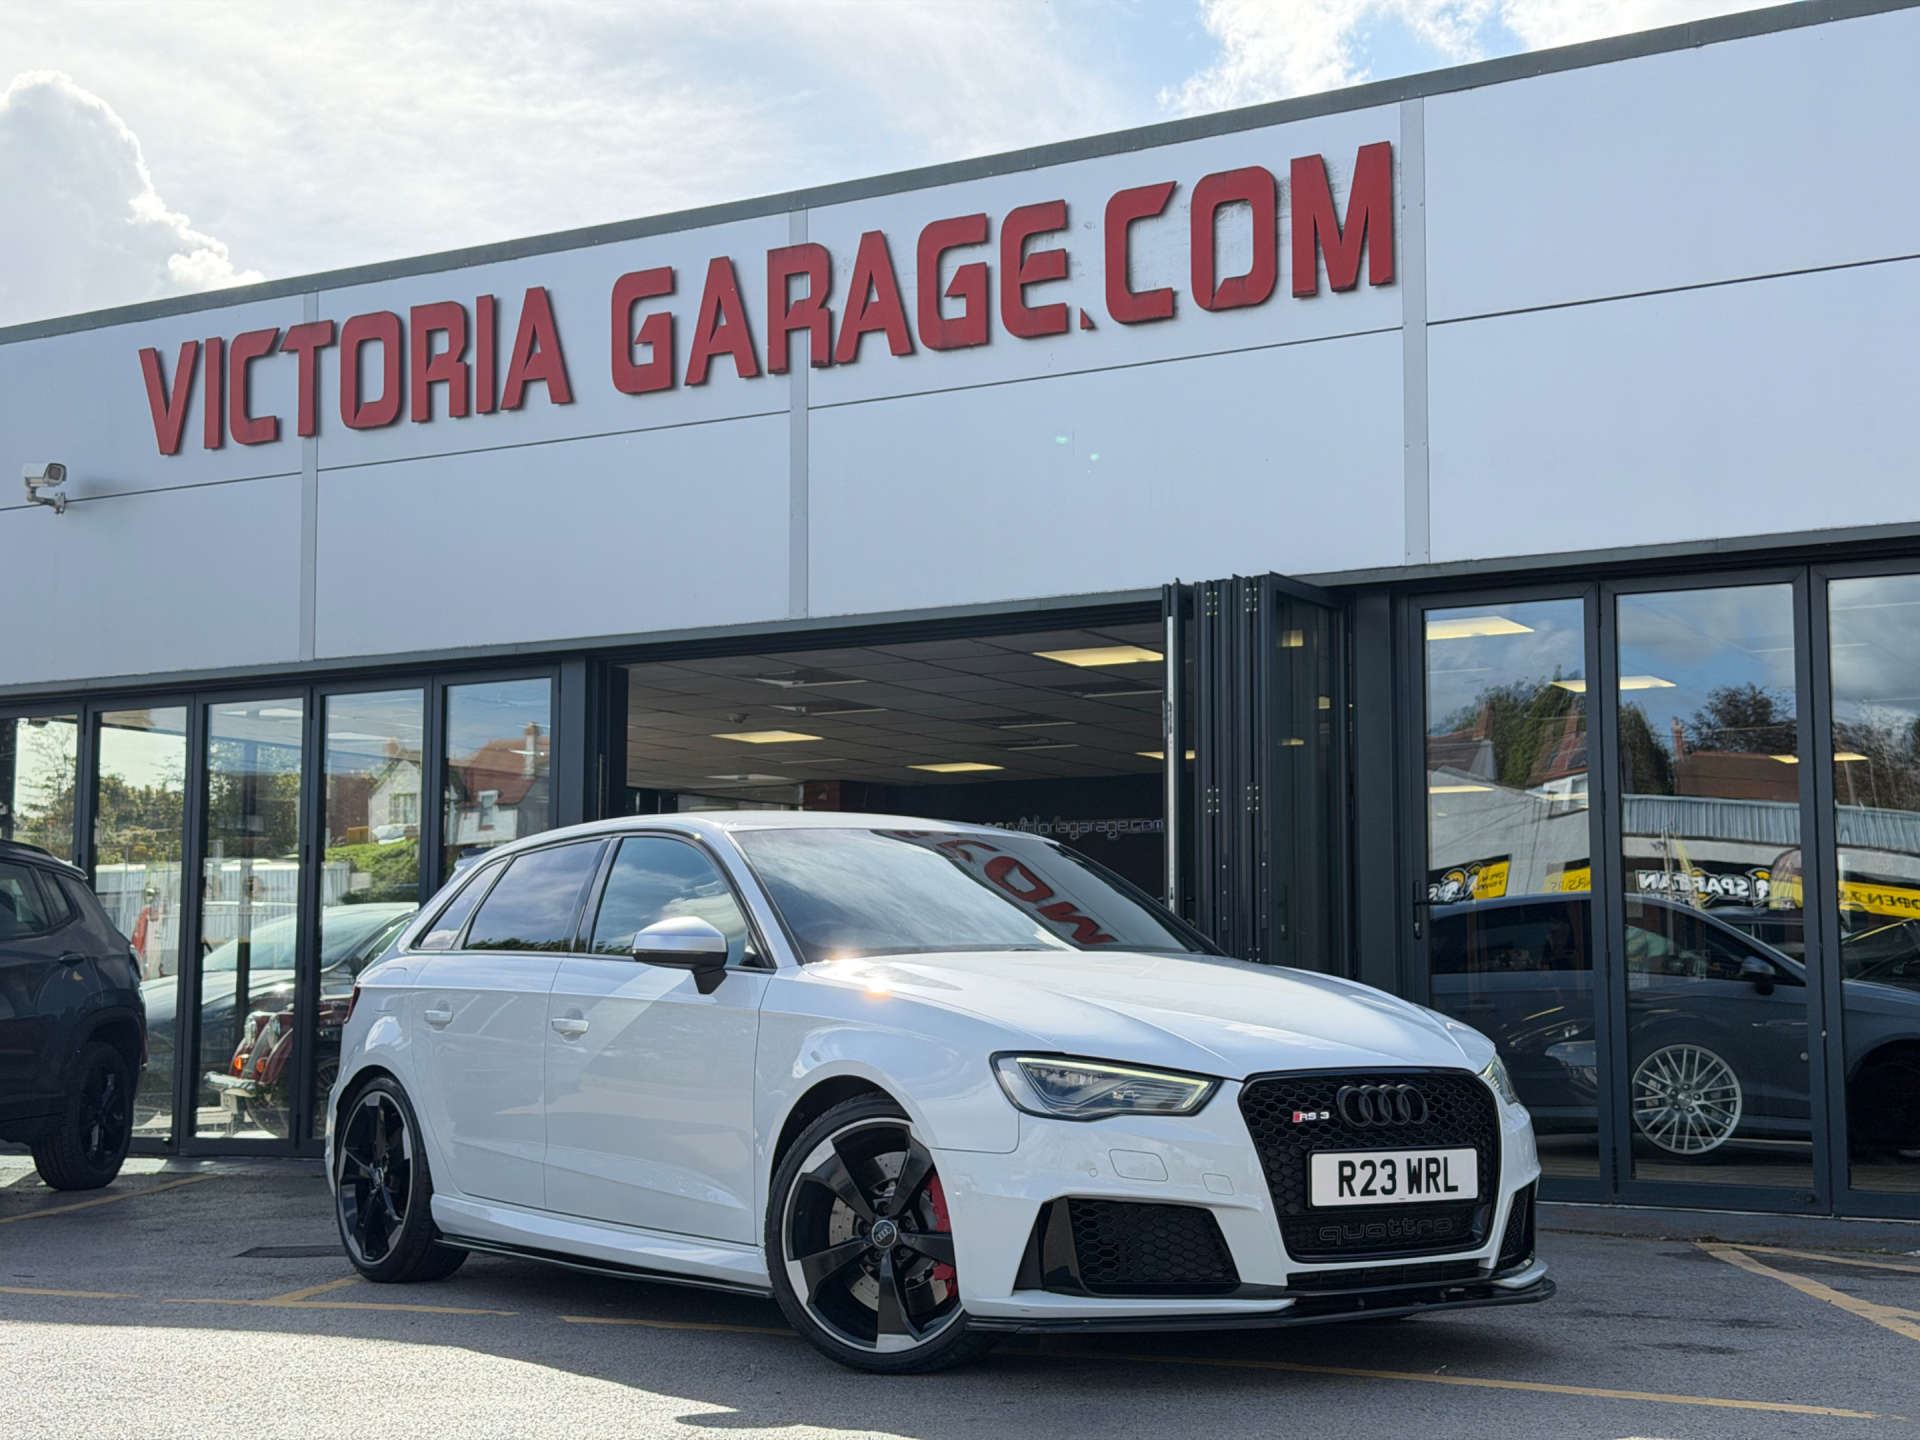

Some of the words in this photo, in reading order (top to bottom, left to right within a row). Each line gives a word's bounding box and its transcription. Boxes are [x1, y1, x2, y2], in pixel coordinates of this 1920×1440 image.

[138, 286, 574, 456] VICTORIA
[611, 141, 1394, 395] GARAGE.COM
[1338, 1159, 1397, 1198] R23
[1406, 1156, 1459, 1195] WRL
[1319, 1217, 1454, 1245] quattro
